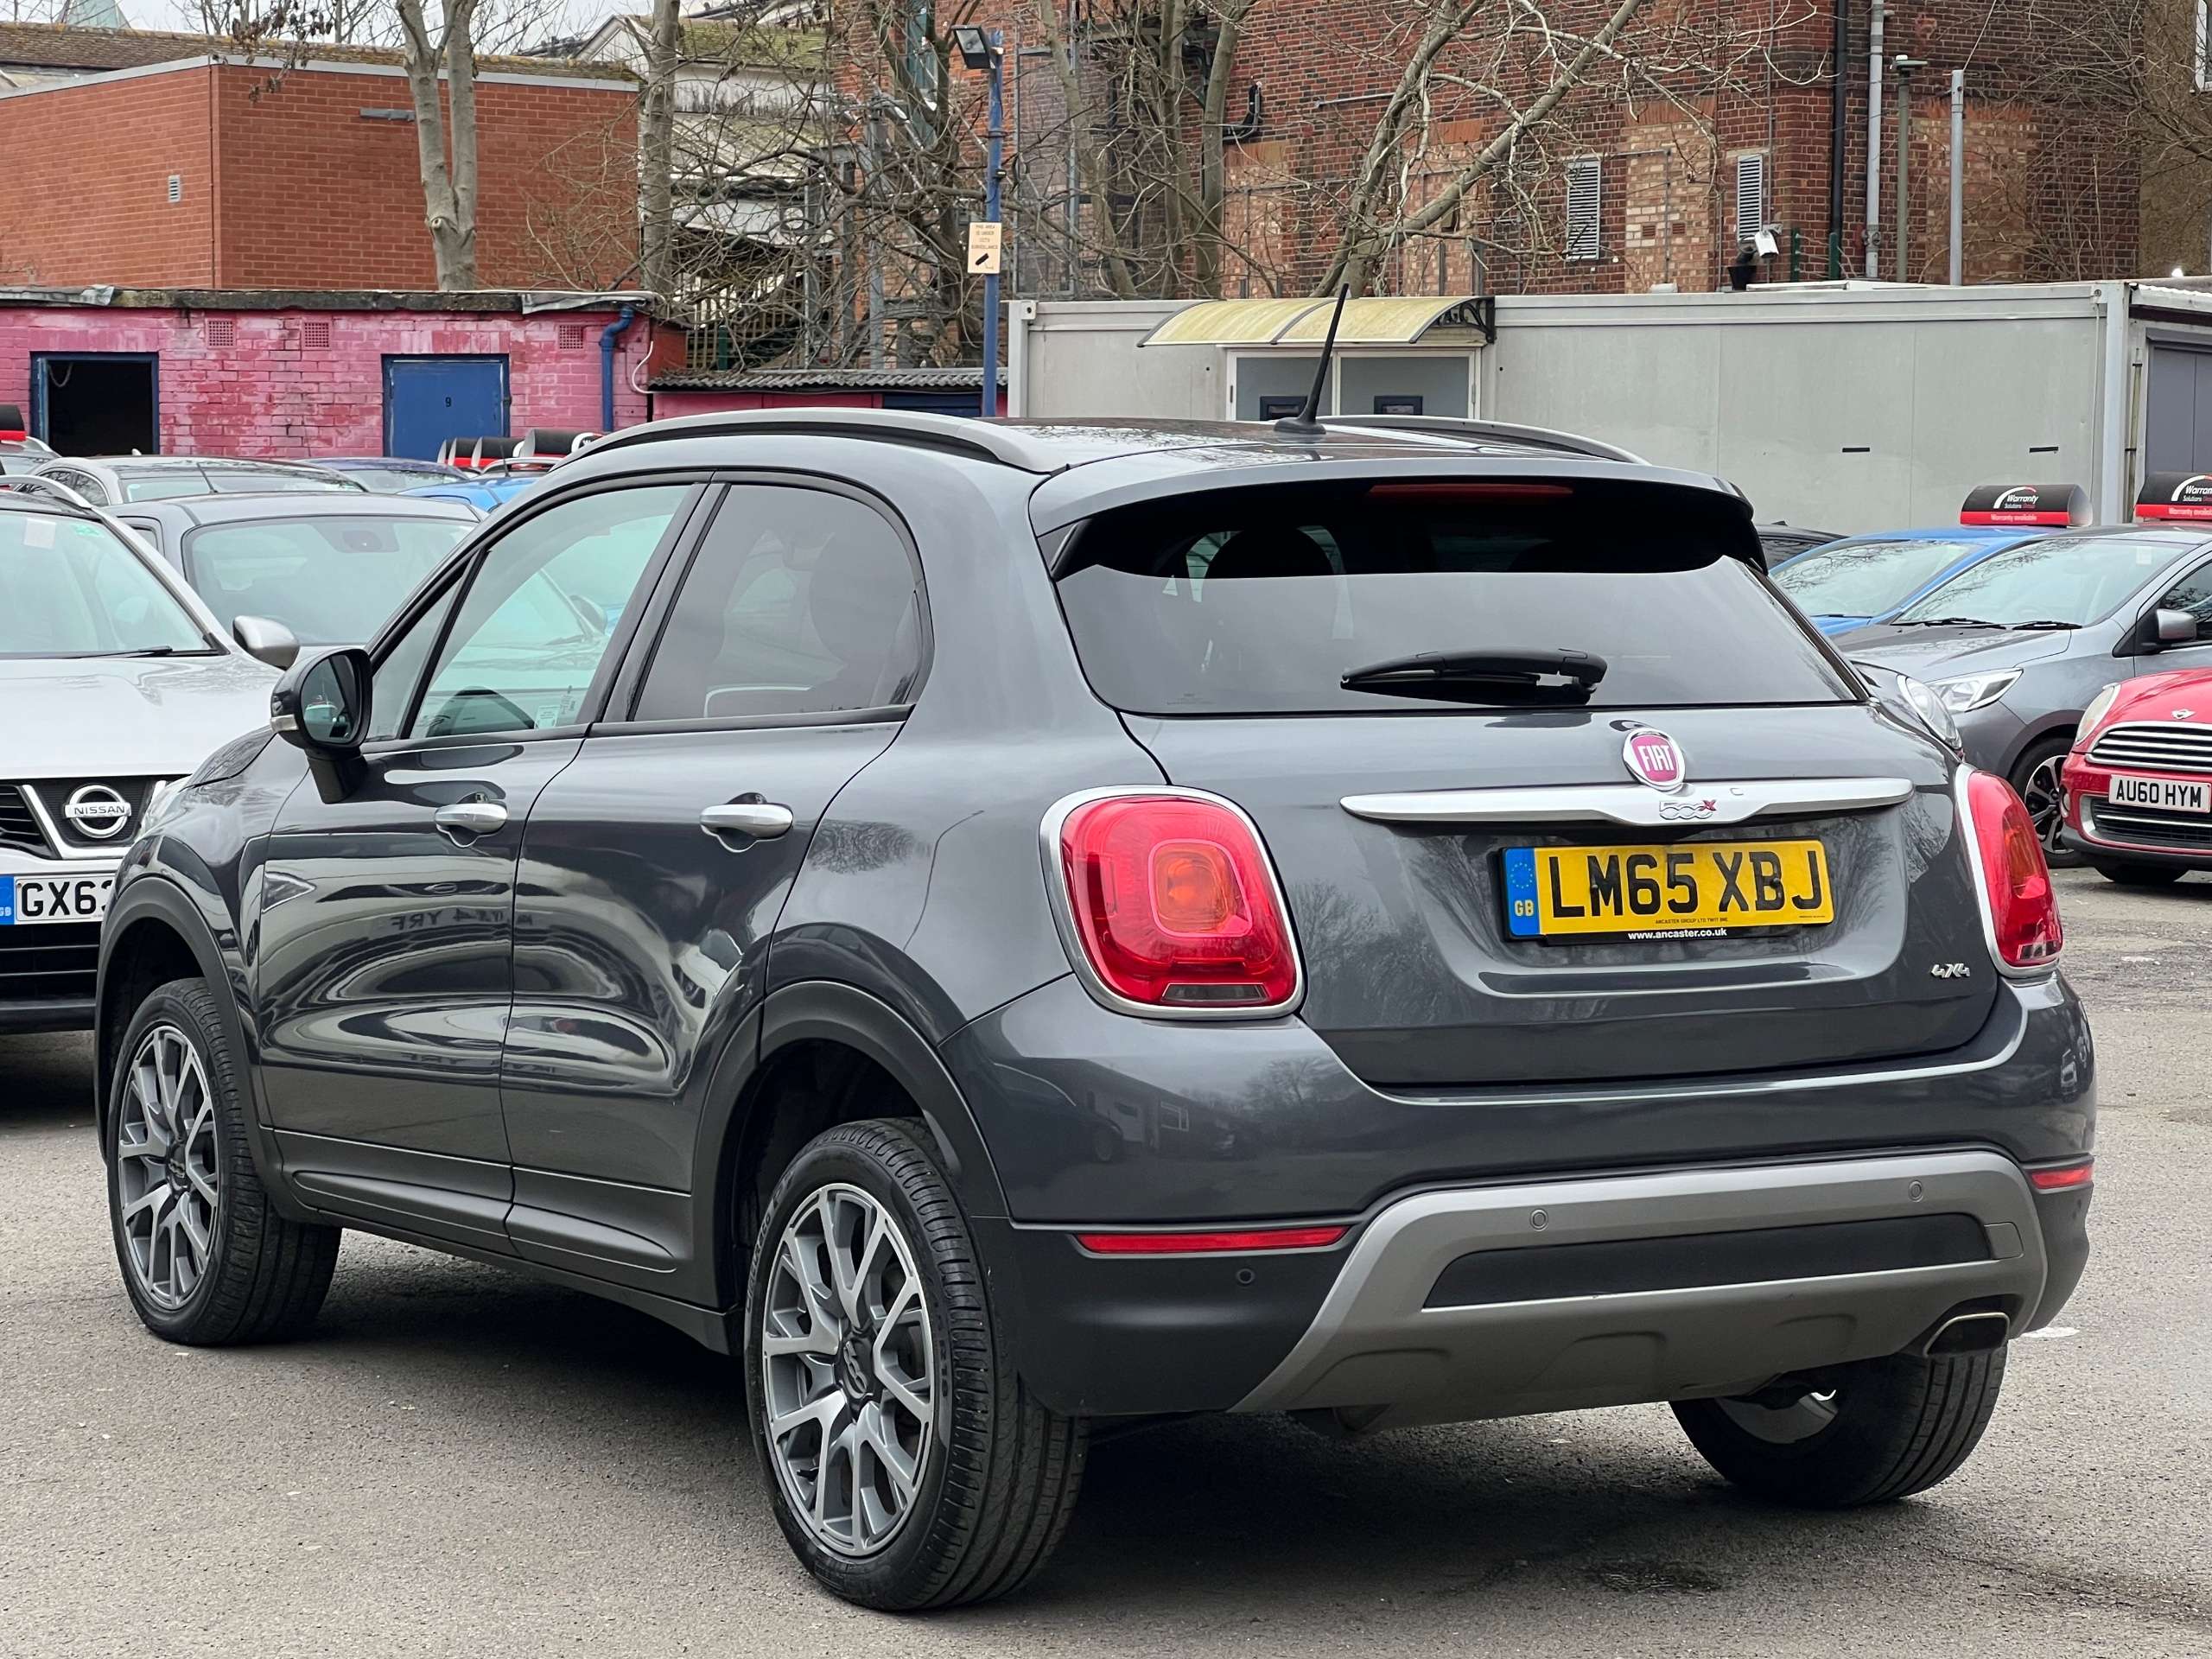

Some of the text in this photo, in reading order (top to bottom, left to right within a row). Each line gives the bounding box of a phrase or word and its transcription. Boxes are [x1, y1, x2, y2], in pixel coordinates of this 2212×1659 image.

[445, 397, 452, 408] 9
[2006, 494, 2038, 504] Warranty
[1637, 744, 1675, 772] FIAT
[2116, 779, 2202, 808] AU60 HYM
[74, 805, 125, 815] NISSAN
[1548, 850, 1823, 918] LM65 XBJ
[1515, 899, 1535, 917] GB
[1628, 927, 1727, 940] www.ancaster.co.uk
